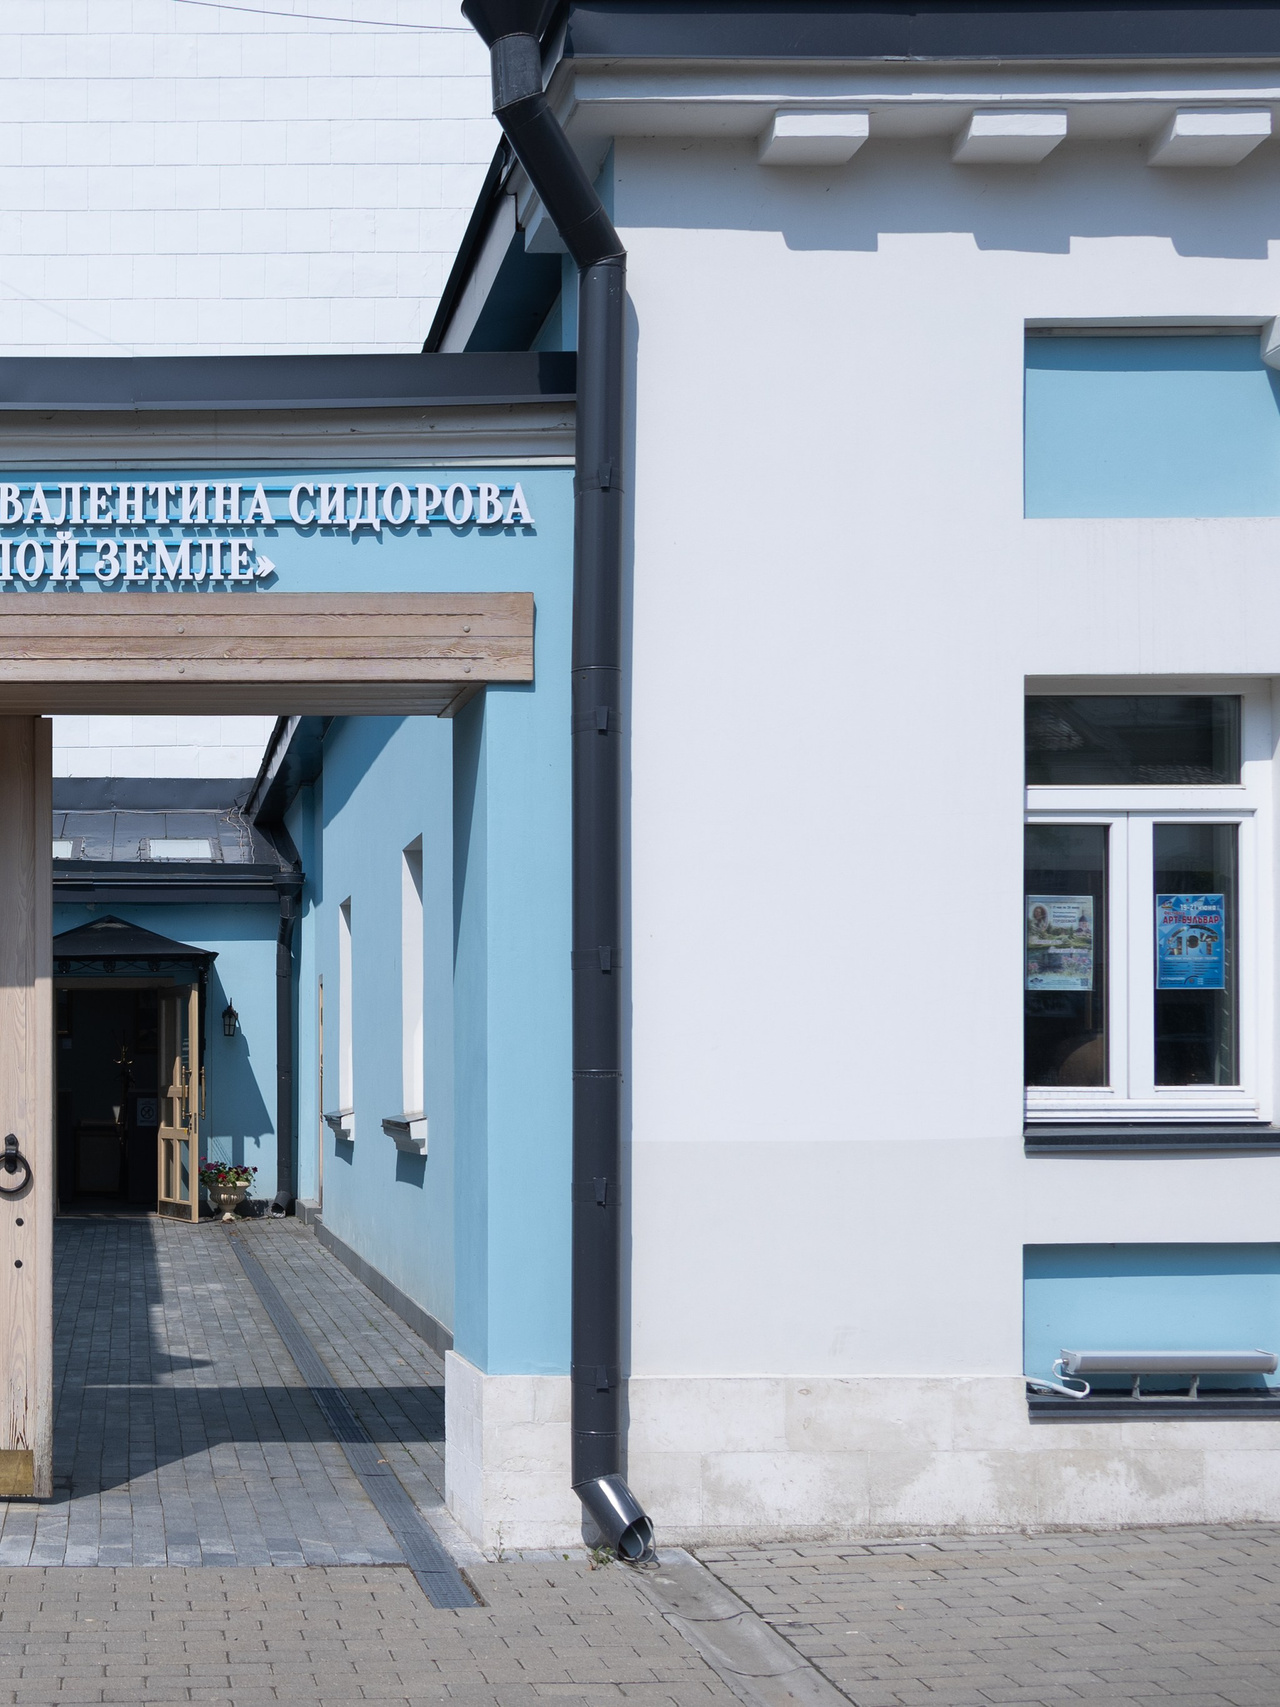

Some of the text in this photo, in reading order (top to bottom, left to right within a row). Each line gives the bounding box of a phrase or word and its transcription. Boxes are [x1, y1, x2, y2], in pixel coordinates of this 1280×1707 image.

[288, 482, 536, 532] СИДОРОВА
[94, 539, 277, 582] ЗЕМЛЕ»
[1162, 915, 1220, 925] АРТ-БУЛЬВАР
